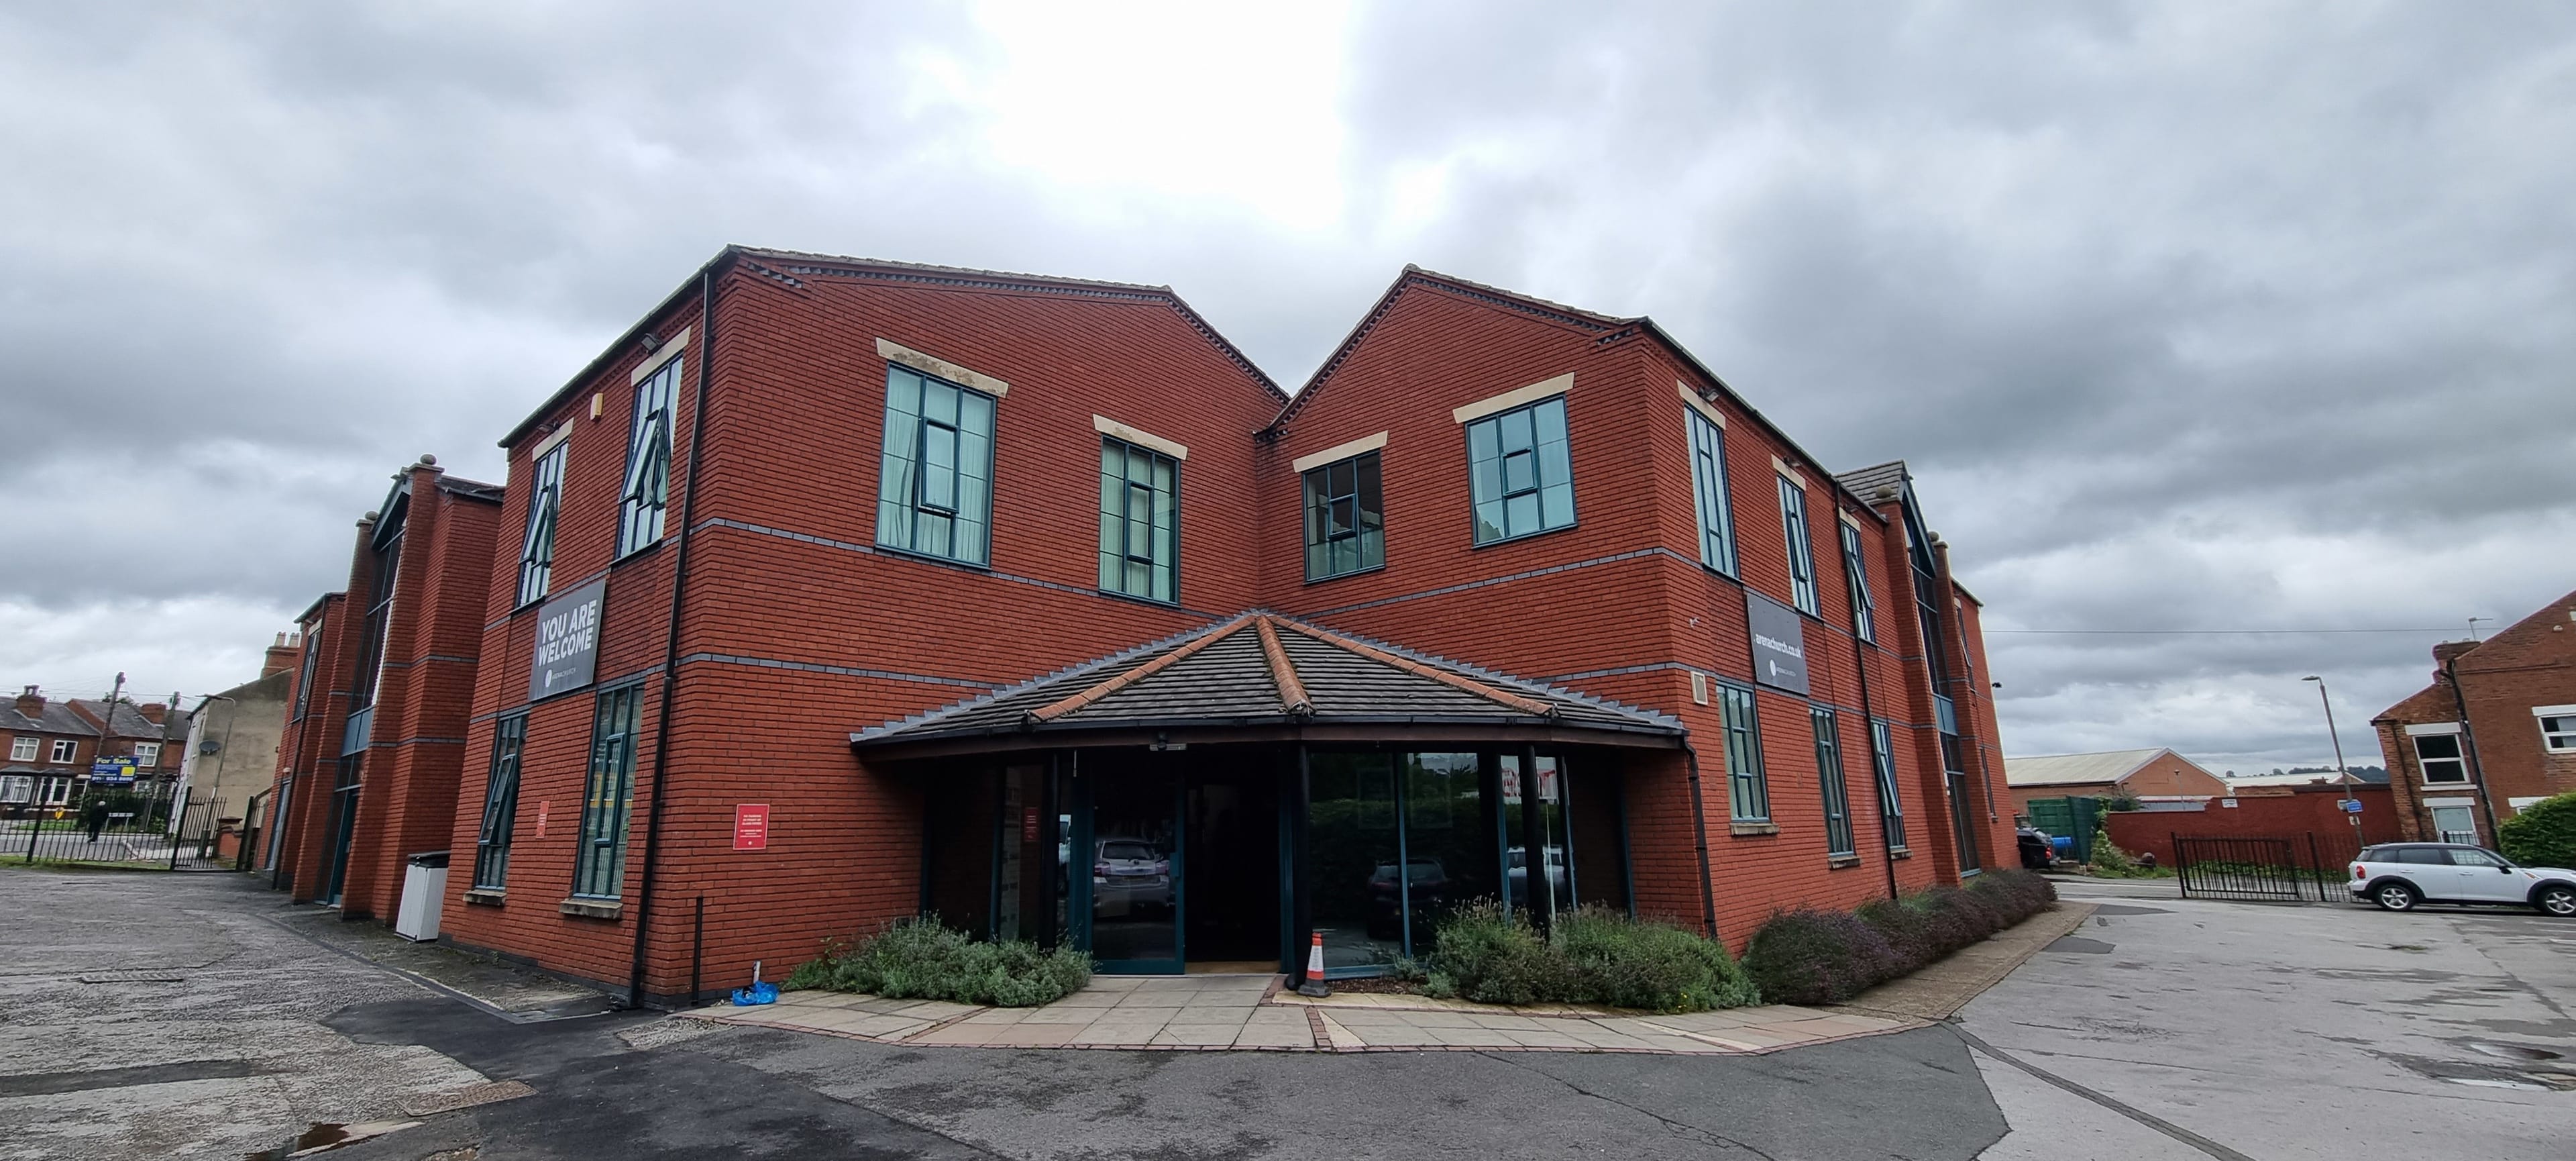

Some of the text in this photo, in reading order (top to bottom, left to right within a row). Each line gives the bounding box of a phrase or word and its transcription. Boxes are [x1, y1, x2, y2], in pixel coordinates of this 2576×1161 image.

[541, 599, 597, 644] YOU ARE
[539, 627, 592, 667] WELCOME
[1755, 634, 1802, 658] arenachurch.co.uk
